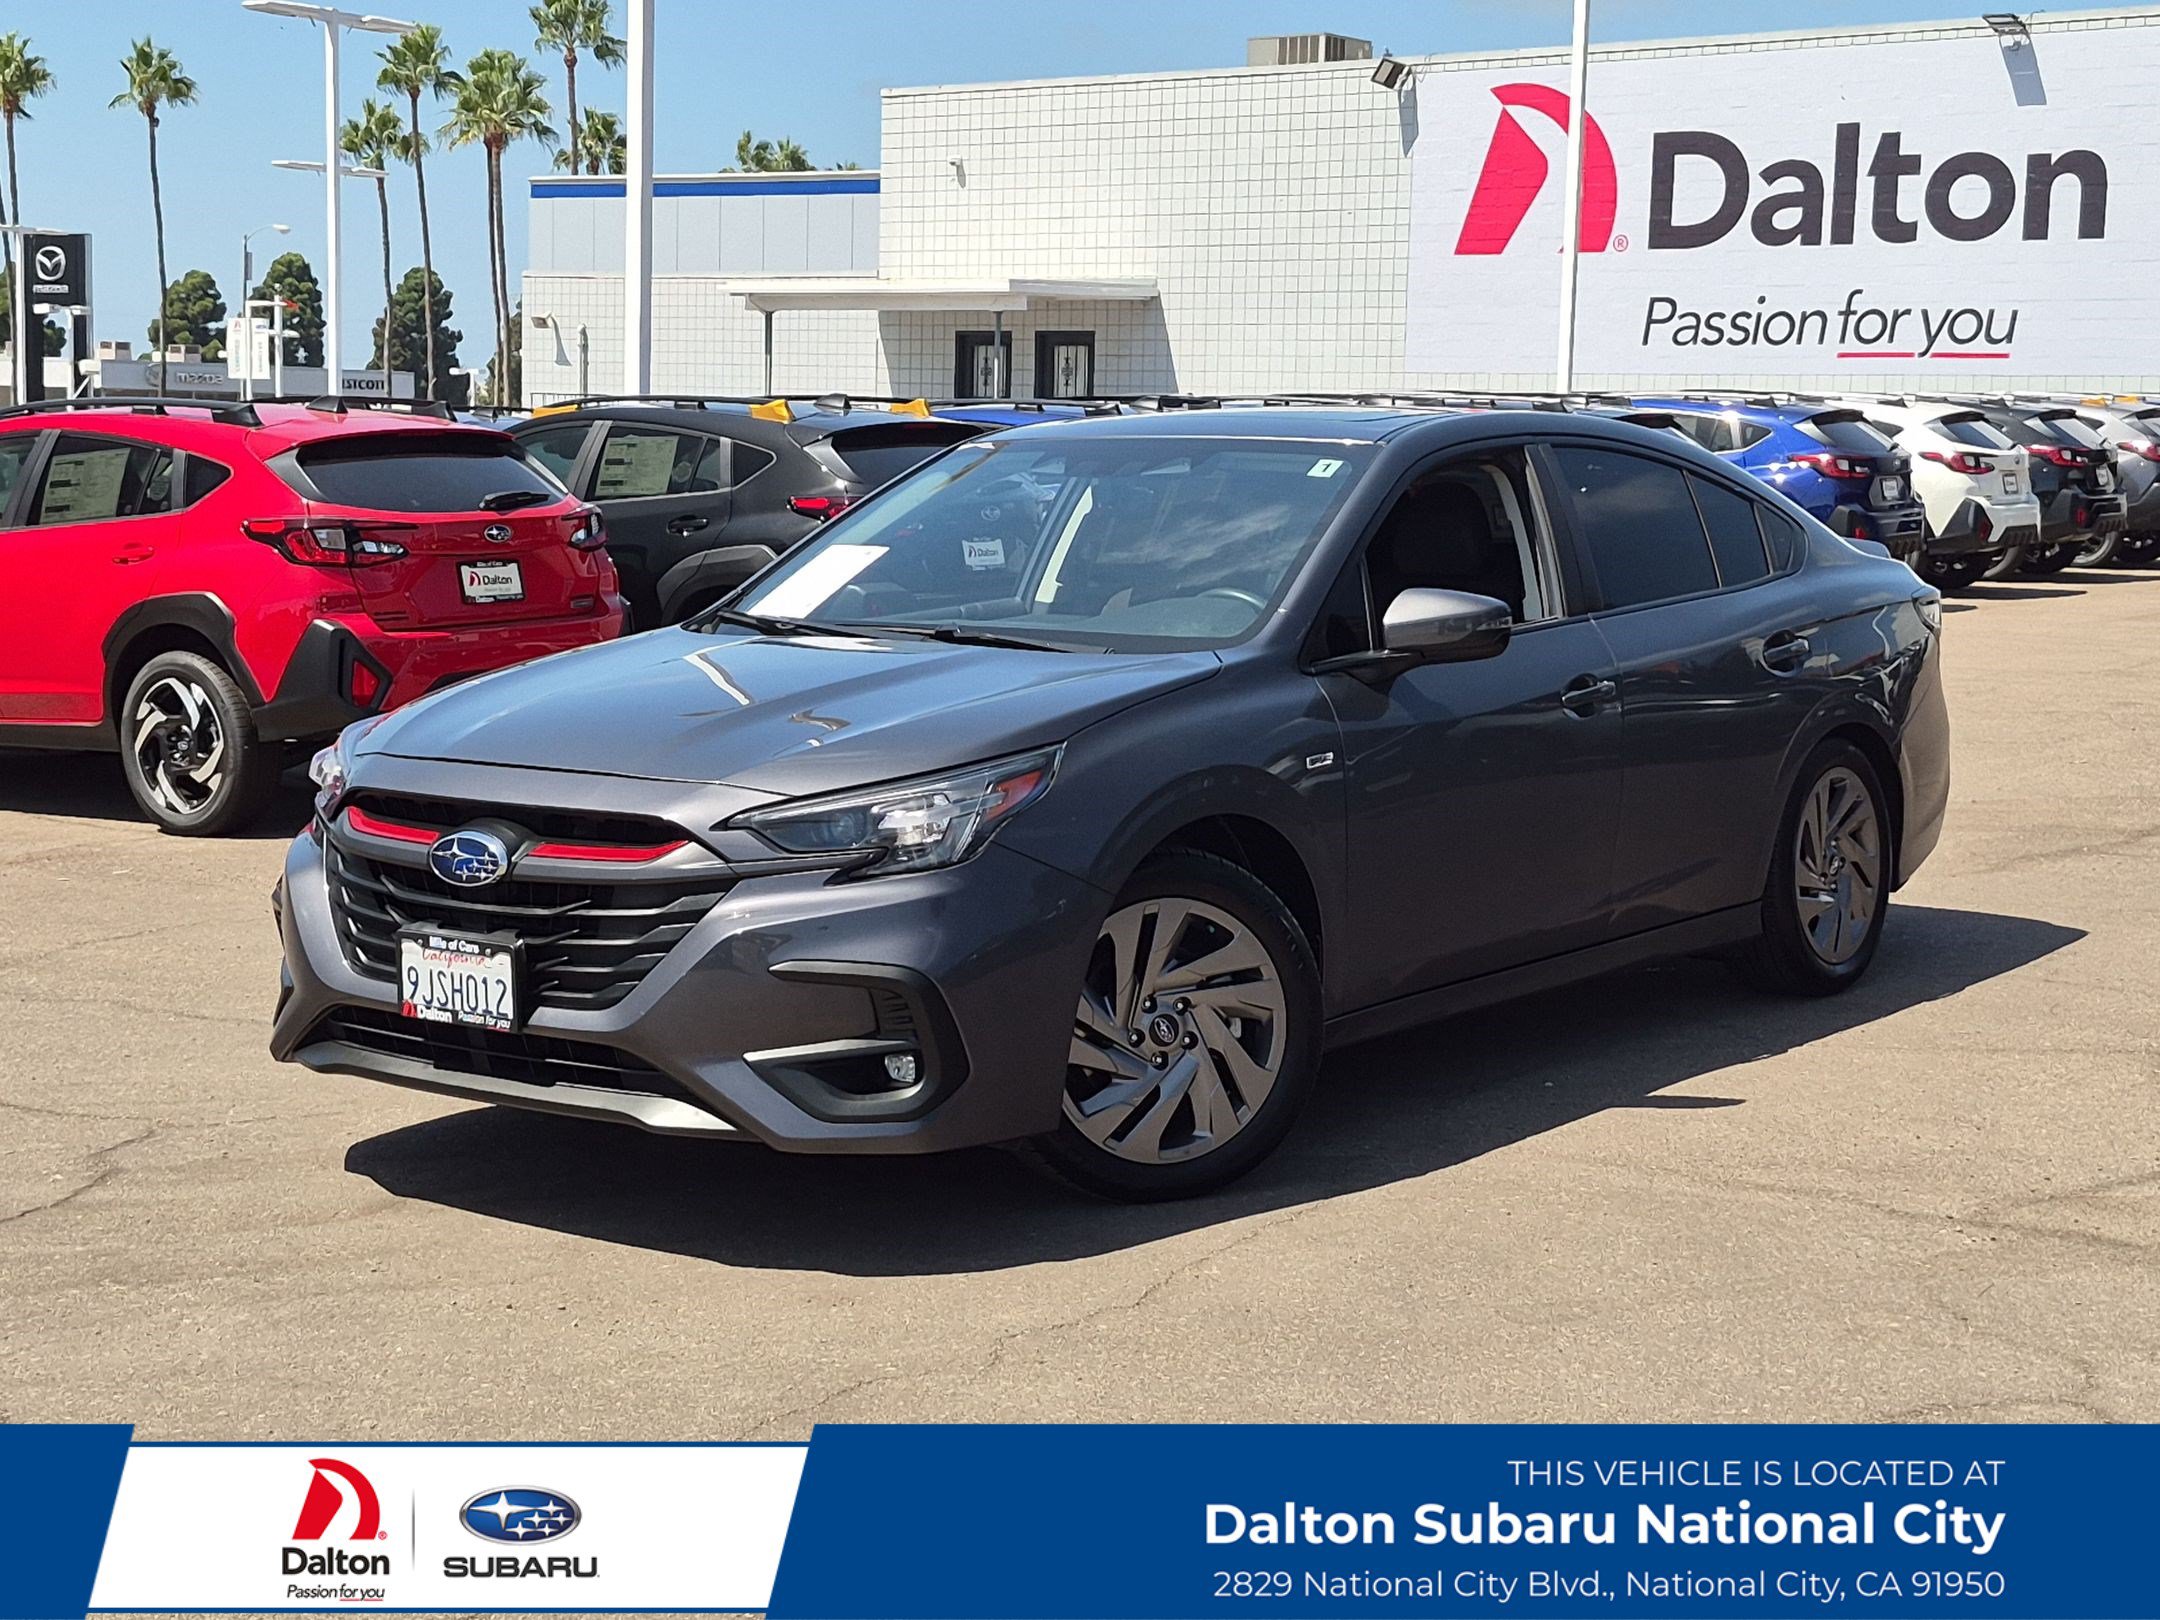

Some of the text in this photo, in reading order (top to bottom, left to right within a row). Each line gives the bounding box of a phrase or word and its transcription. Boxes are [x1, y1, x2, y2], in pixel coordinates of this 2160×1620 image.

[1647, 122, 2108, 250] Dalton
[1642, 288, 2019, 358] Passion for you
[482, 574, 513, 586] Dalton
[447, 939, 457, 951] of
[458, 940, 480, 954] Cars
[422, 948, 490, 968] California
[407, 965, 509, 1018] 9JSH012
[416, 1004, 453, 1023] Dalton
[457, 1011, 511, 1029] Passion for you
